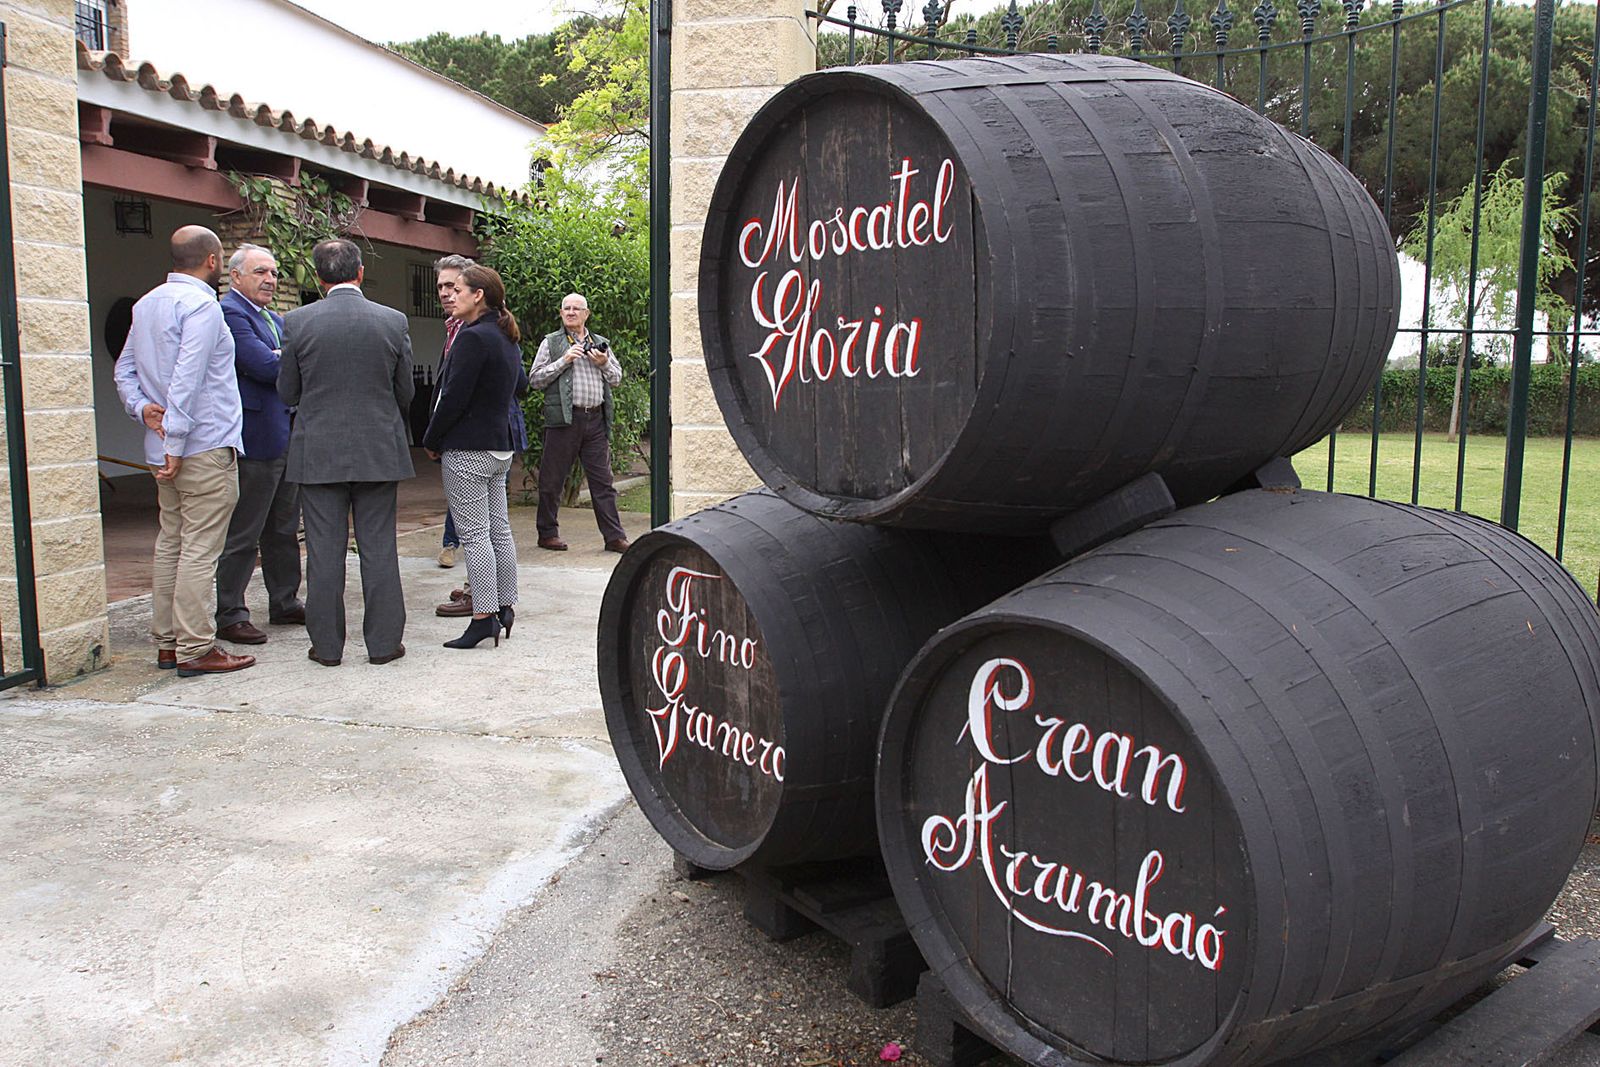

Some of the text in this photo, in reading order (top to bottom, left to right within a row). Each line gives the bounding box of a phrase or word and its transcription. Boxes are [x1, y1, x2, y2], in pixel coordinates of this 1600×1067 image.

[738, 156, 955, 268] Moscatel
[749, 269, 922, 412] Gloria
[657, 566, 758, 670] Fino
[955, 657, 1188, 813] Crean
